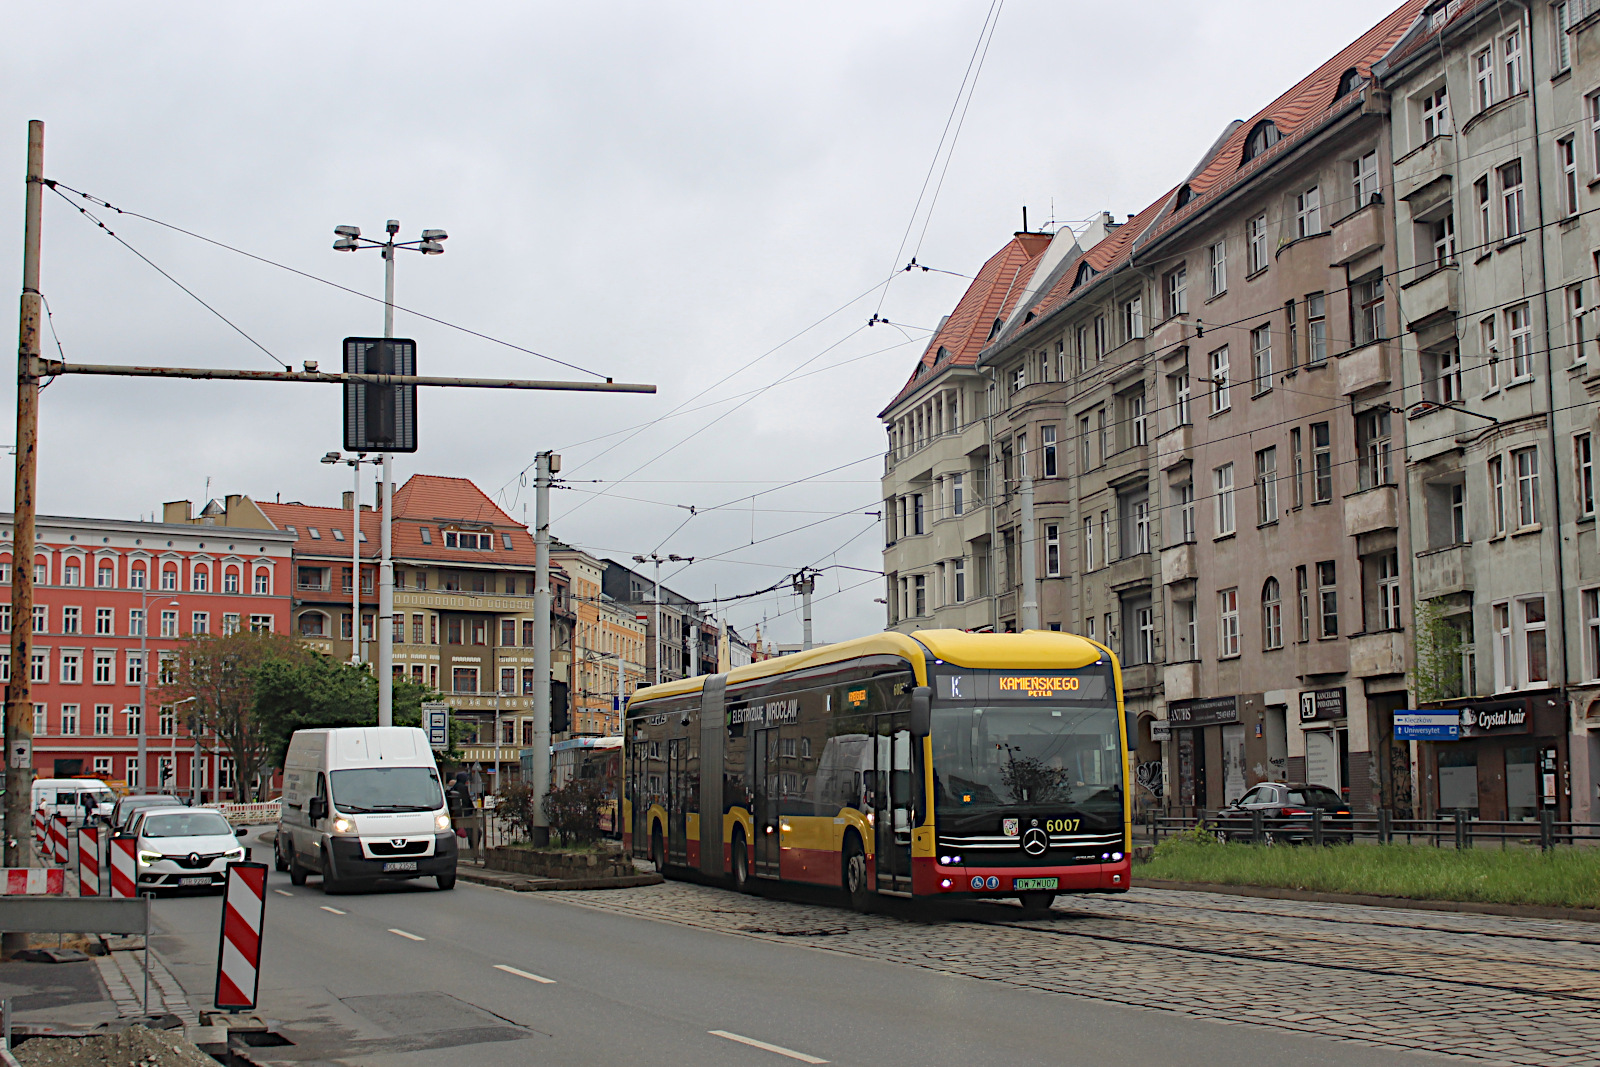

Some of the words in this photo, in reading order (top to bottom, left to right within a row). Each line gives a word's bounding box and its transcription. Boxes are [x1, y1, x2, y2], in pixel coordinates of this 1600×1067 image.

[951, 676, 962, 698] K
[999, 676, 1080, 690] KAMIEŃSKIEGO
[1478, 710, 1507, 730] Crystal
[1508, 708, 1526, 725] hair
[1404, 727, 1440, 735] Uniwersytet
[1046, 819, 1081, 832] 6007
[1018, 879, 1029, 889] DW
[1031, 879, 1056, 888] 7WU07
